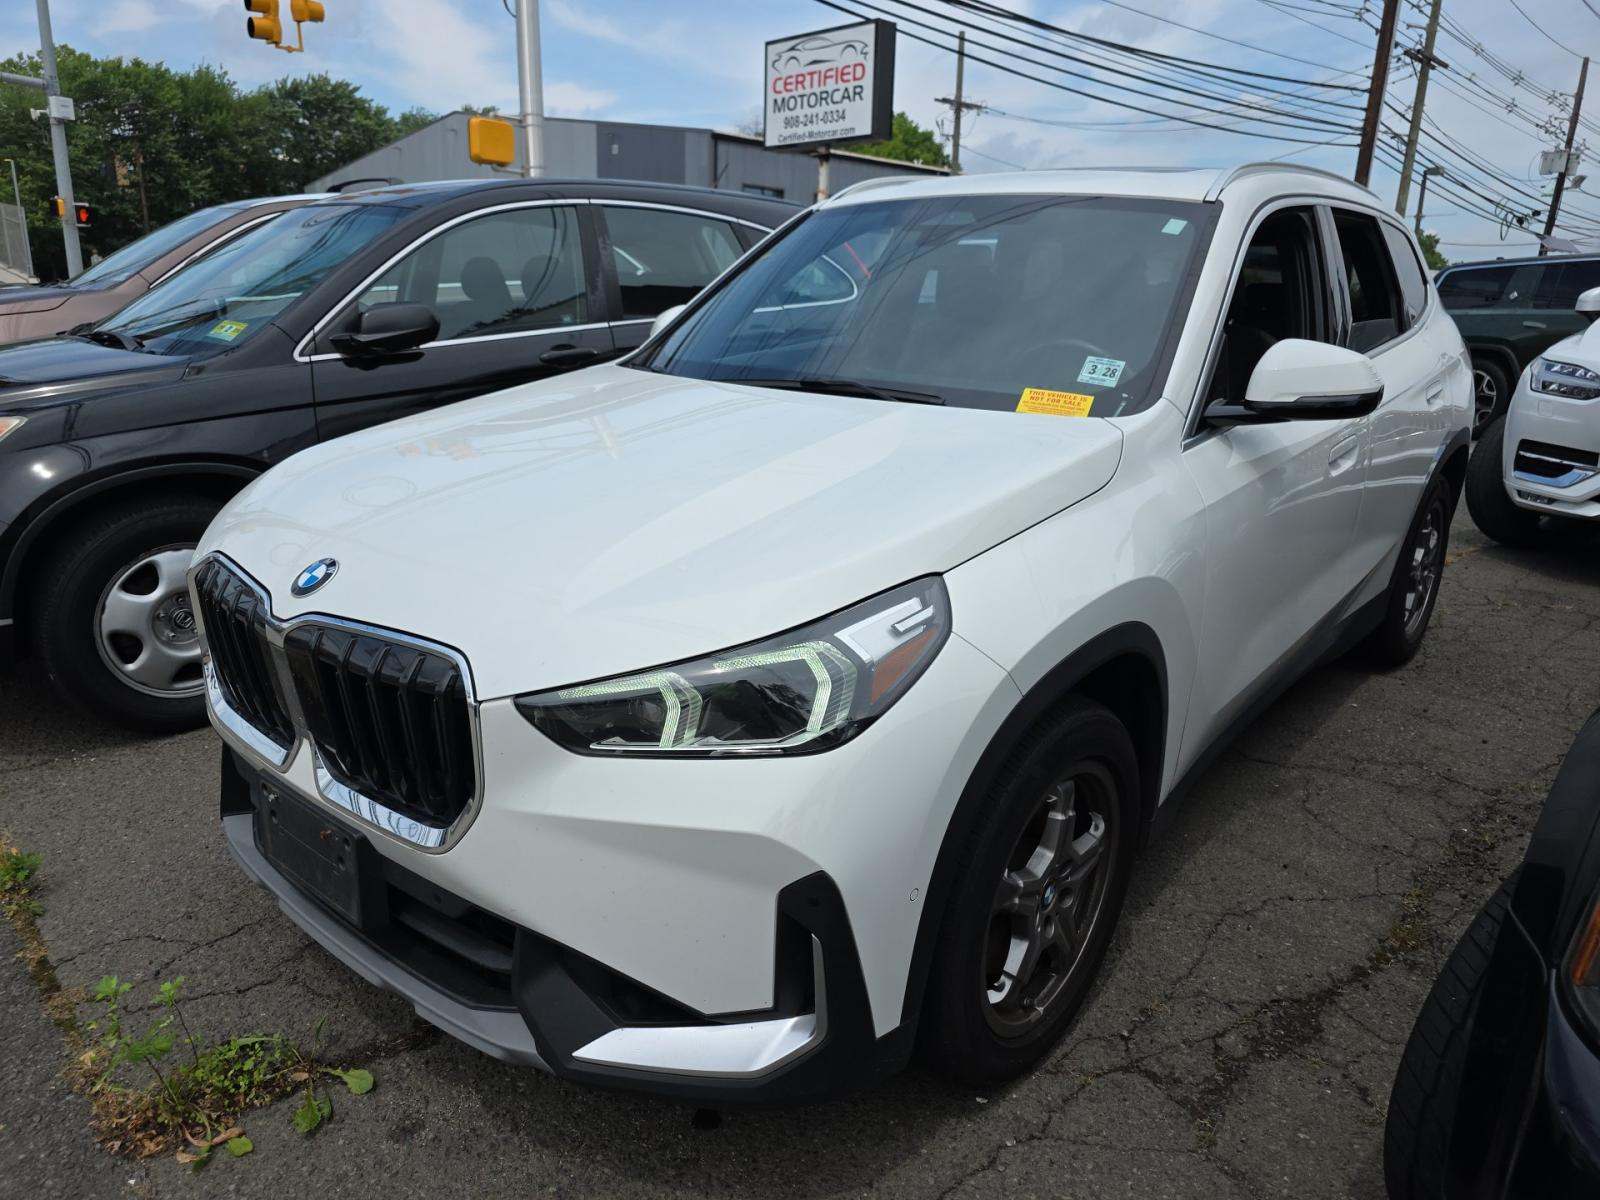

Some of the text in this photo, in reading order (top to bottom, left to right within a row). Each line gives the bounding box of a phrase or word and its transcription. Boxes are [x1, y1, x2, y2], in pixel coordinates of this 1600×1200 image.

[772, 62, 866, 95] CERTIFIED
[773, 85, 864, 114] MOTORCAR
[783, 109, 846, 129] 908-241-0334
[1088, 364, 1118, 378] 3 28
[1047, 392, 1078, 400] VEHICLE
[1063, 399, 1082, 407] SALE
